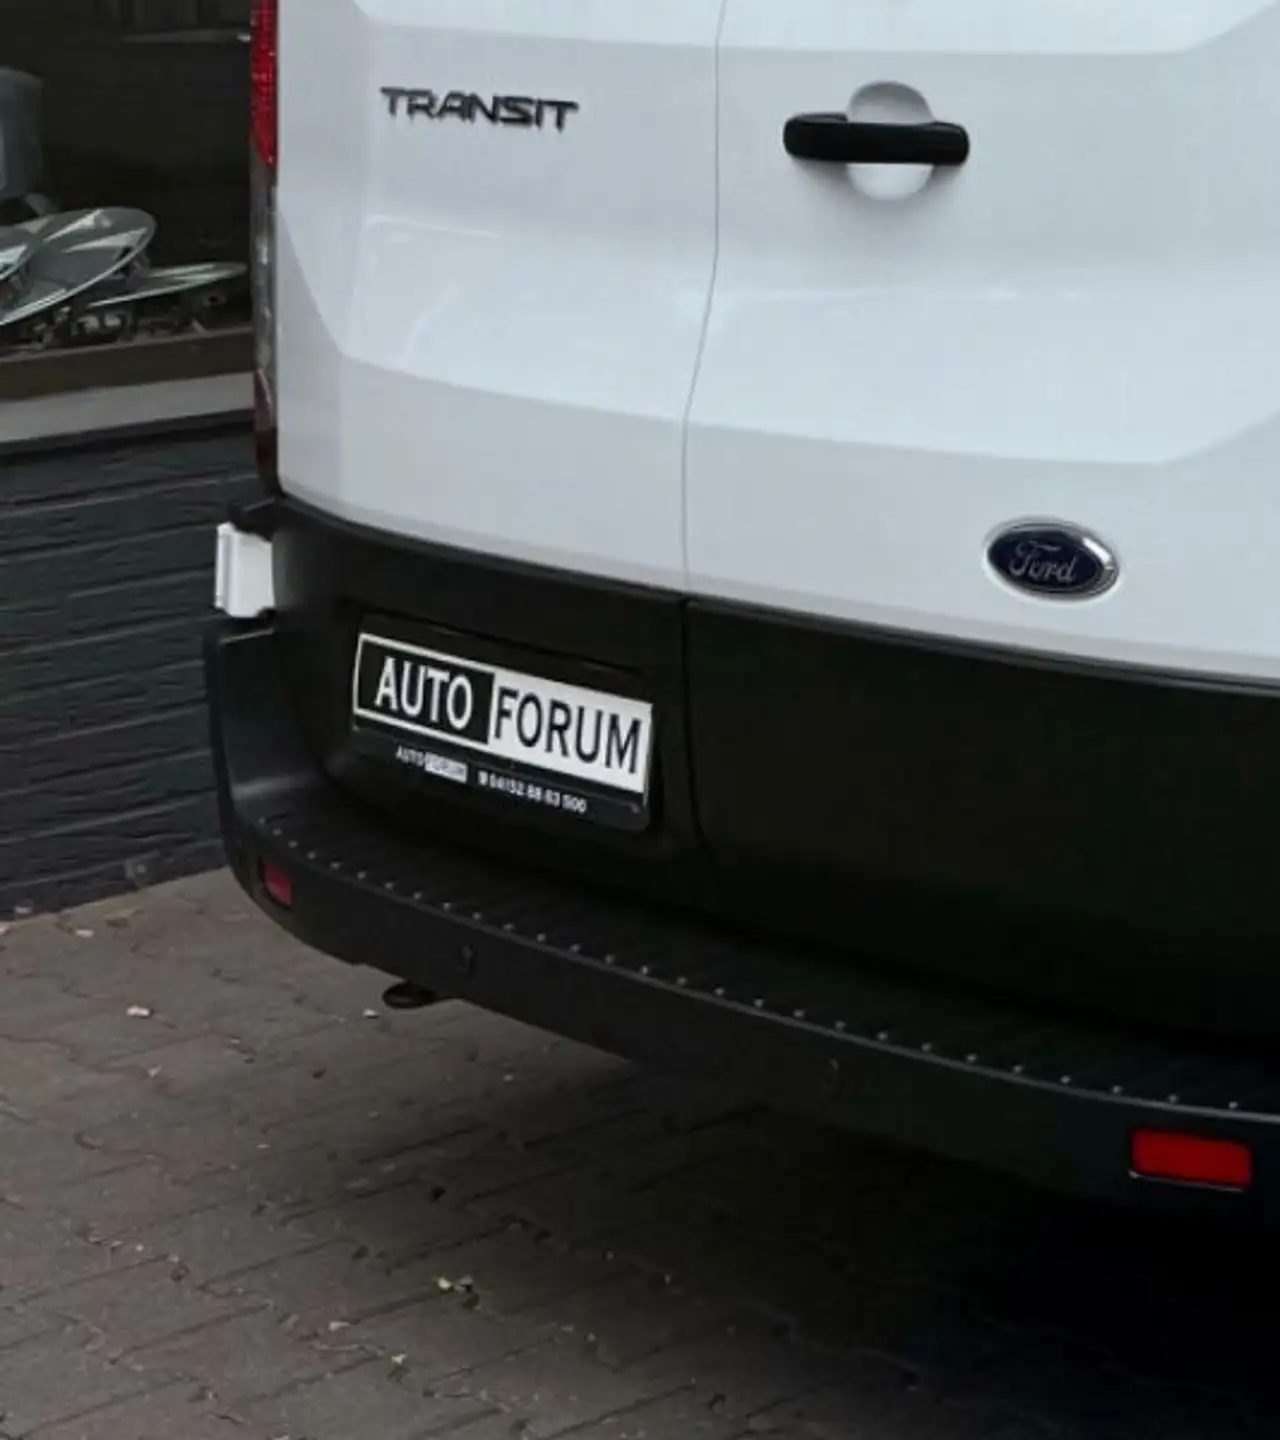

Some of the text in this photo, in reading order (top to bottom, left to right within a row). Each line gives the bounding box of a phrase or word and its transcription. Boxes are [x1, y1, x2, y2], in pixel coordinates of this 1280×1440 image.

[379, 86, 580, 133] TRANSIT
[1009, 540, 1080, 583] Ford
[375, 657, 642, 774] AUTO FORUM
